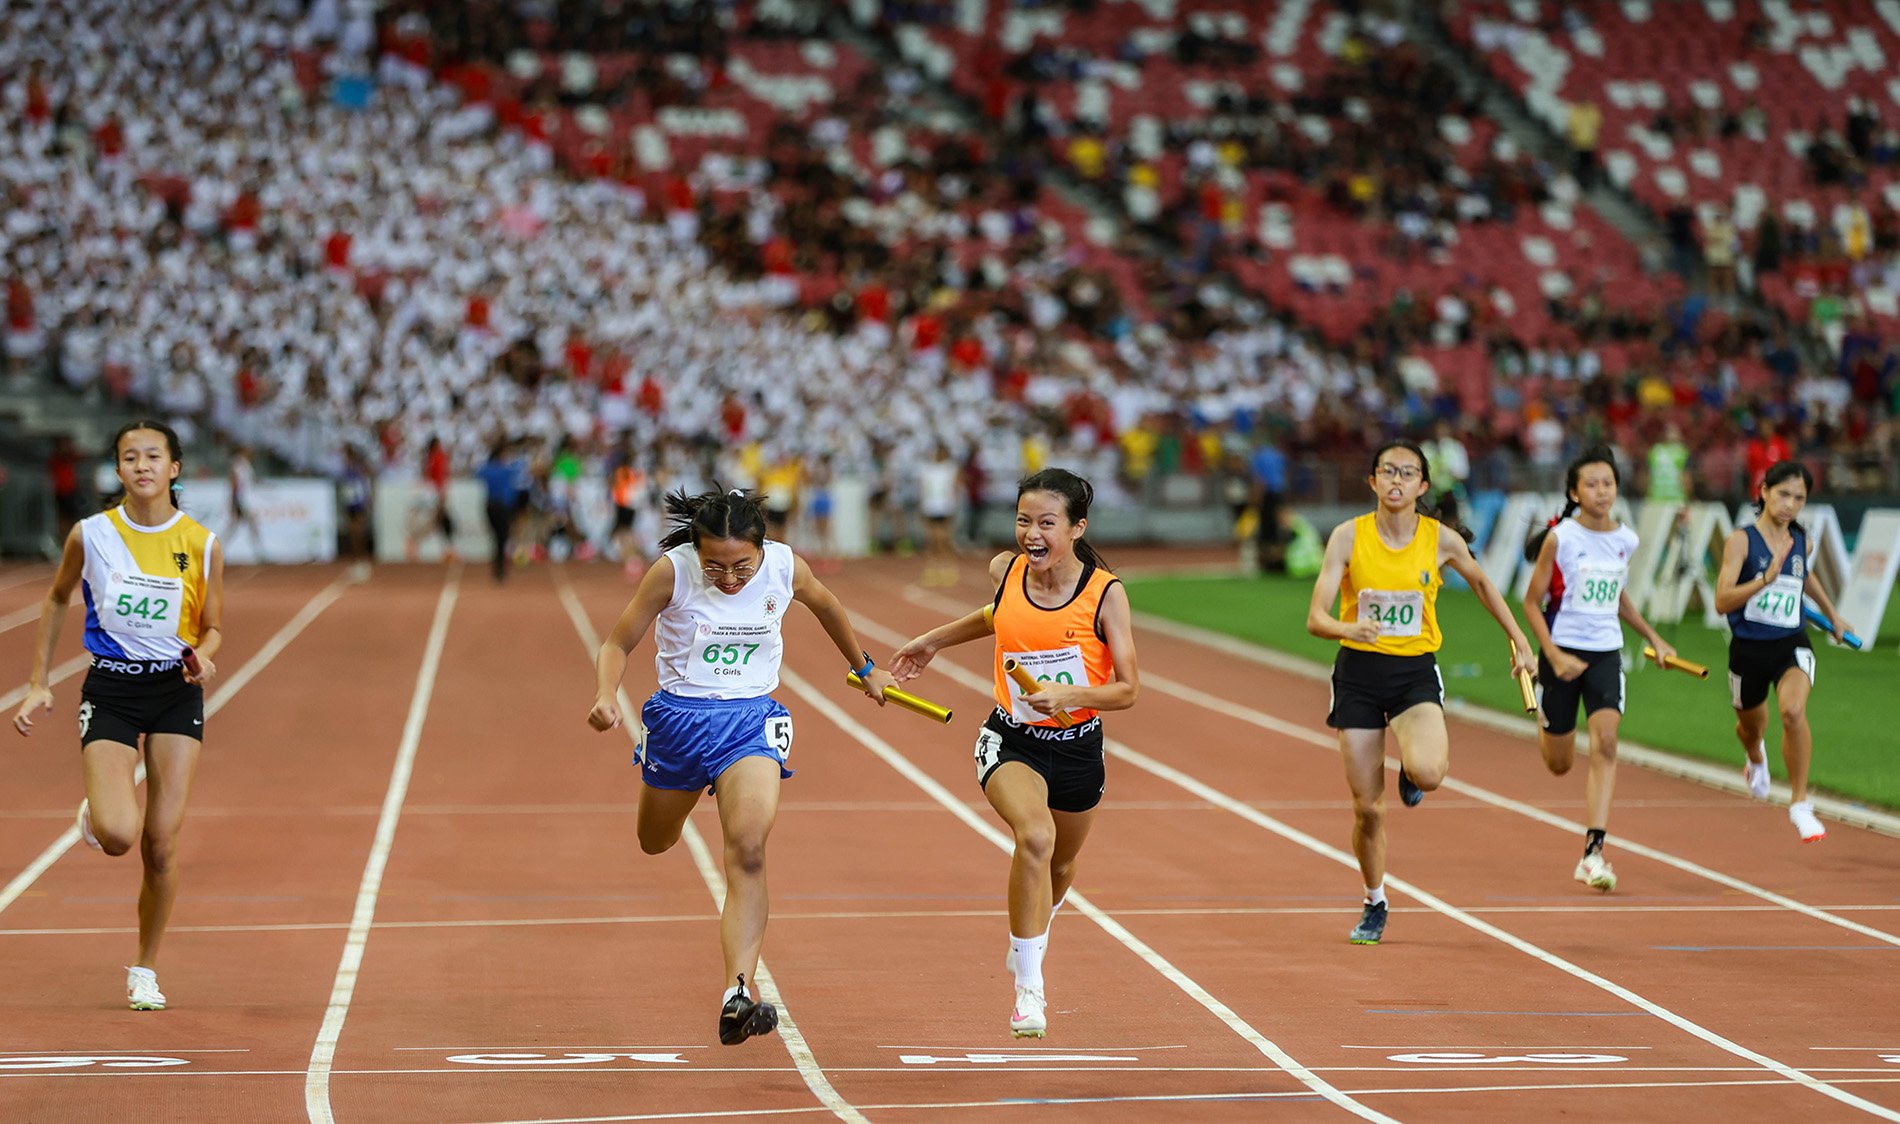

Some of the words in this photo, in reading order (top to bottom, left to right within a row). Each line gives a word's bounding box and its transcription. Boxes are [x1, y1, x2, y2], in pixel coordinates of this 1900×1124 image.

[1583, 579, 1619, 602] 388
[115, 593, 169, 620] 542
[1368, 603, 1414, 625] 340
[1757, 591, 1796, 617] 470
[702, 643, 760, 665] 657
[97, 660, 143, 675] PRO
[149, 659, 181, 674] NIK
[714, 667, 720, 675] C
[722, 668, 741, 676] Girls
[995, 704, 1021, 728] RO
[1025, 726, 1077, 741] NIKE
[1080, 715, 1100, 738] PR
[774, 722, 789, 752] 5
